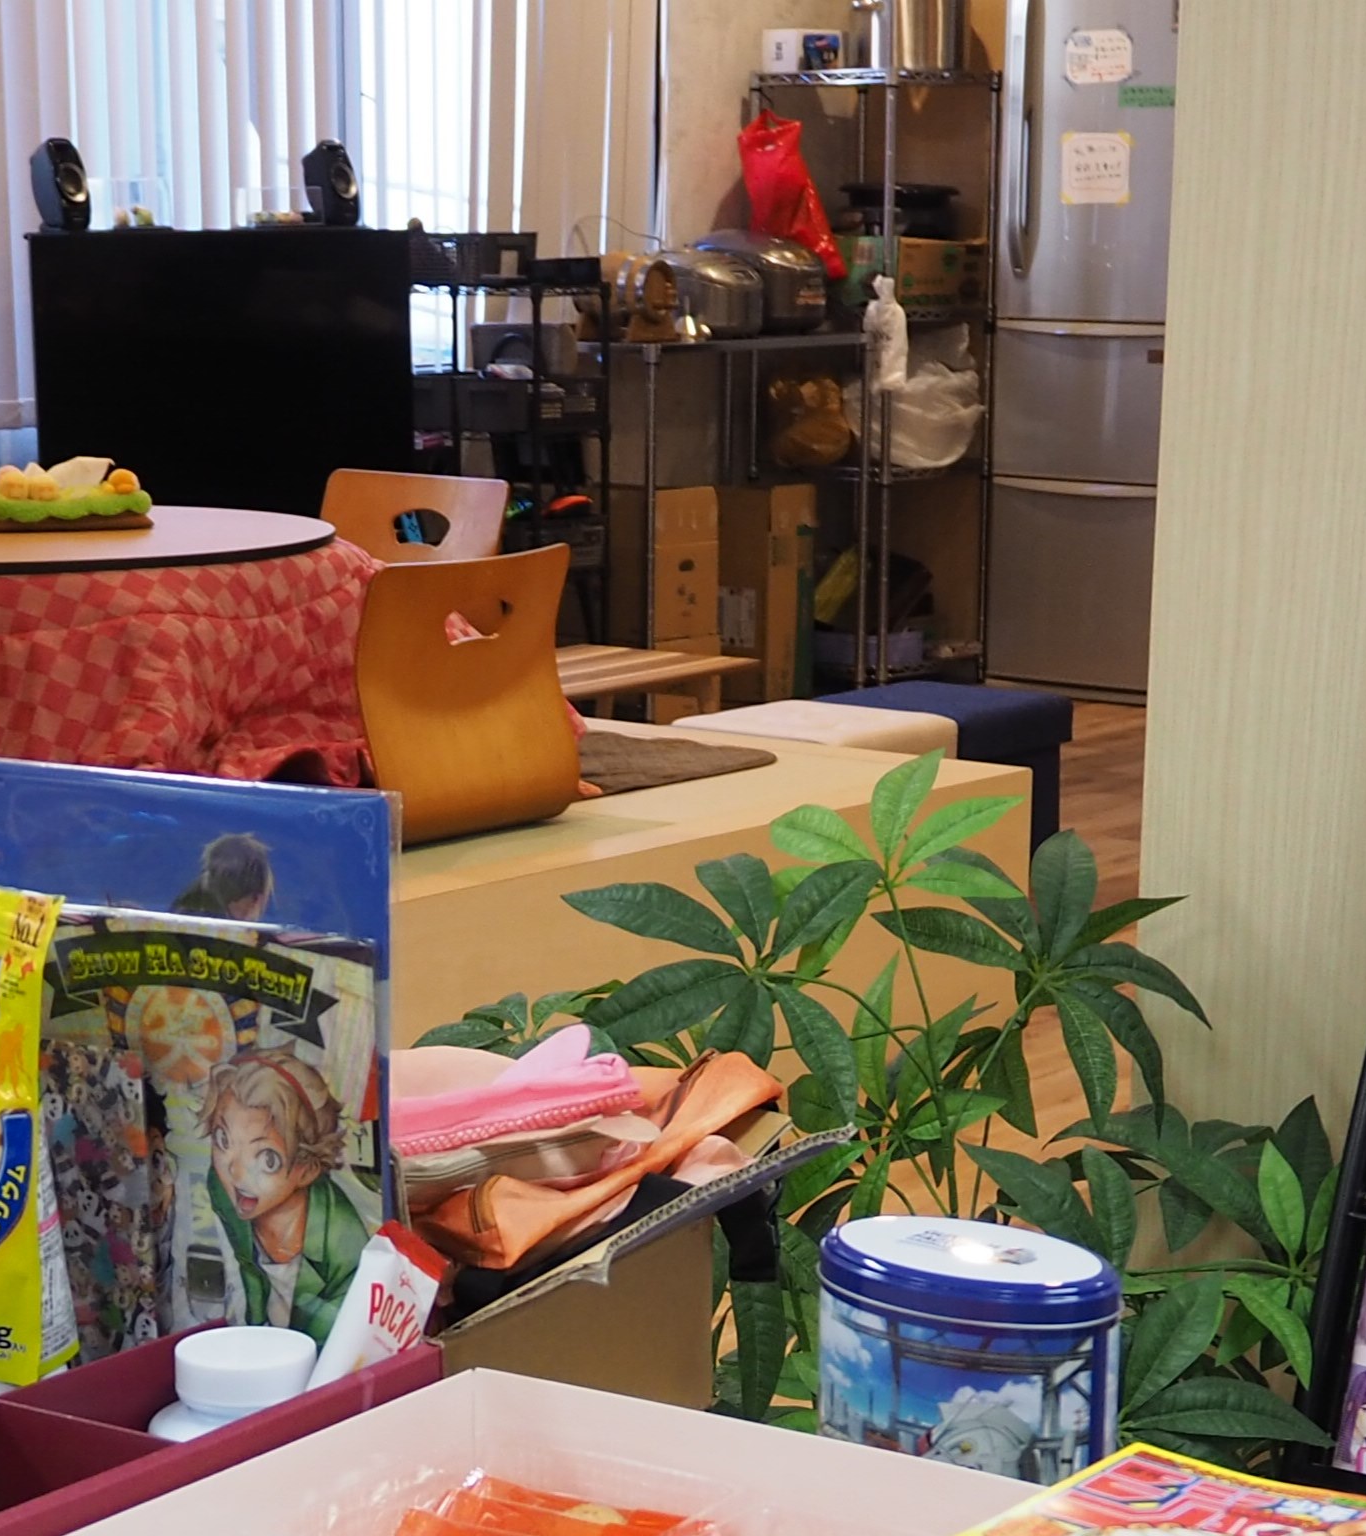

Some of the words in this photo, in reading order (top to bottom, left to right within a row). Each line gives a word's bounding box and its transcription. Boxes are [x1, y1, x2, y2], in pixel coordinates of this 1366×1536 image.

[67, 947, 140, 980] SHOW
[144, 943, 186, 977] HA
[368, 1282, 422, 1353] POCKY
